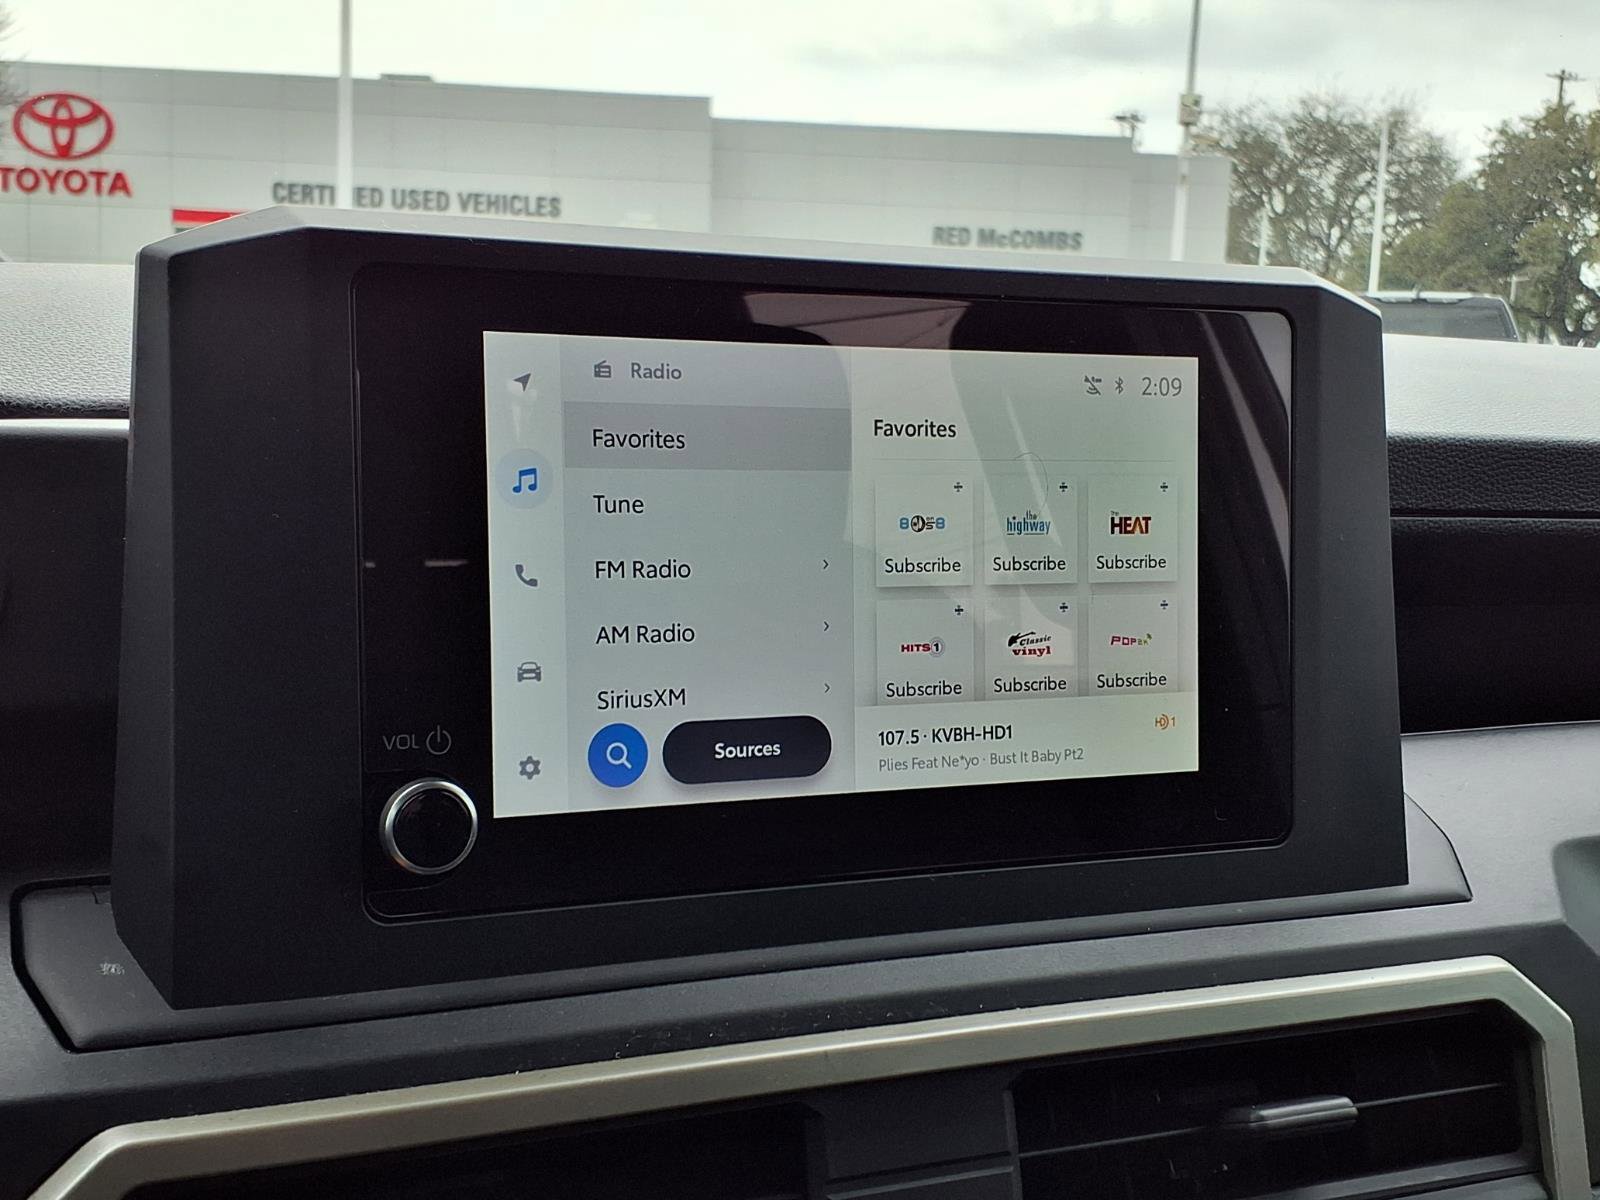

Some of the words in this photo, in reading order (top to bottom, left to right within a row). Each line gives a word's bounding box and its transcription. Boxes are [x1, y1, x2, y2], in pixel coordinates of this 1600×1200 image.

[0, 167, 132, 198] TOYOTA
[272, 182, 383, 208] CERTIED
[391, 188, 450, 211] USED
[457, 192, 561, 217] VEHICLES
[933, 226, 971, 246] RED
[977, 228, 1083, 250] McCOMBS
[631, 362, 682, 380] Radio
[1141, 377, 1183, 397] 2:09
[873, 419, 957, 438] Favorites
[592, 429, 686, 449] Favorites
[593, 495, 644, 514] Tune
[1006, 516, 1050, 536] highway
[1110, 516, 1151, 535] HEAT
[595, 560, 626, 579] FM
[633, 559, 691, 579] Radio
[884, 557, 962, 574] Subscribe
[992, 556, 1066, 572] Subscribe
[1096, 554, 1167, 570] Subscribe
[596, 626, 629, 645] AM
[636, 623, 695, 644] Radio
[1019, 633, 1051, 647] Classic
[1012, 645, 1051, 657] vinyl
[886, 682, 963, 698] Subscribe
[993, 677, 1067, 694] Subscribe
[1097, 673, 1168, 689] Subscribe
[597, 688, 686, 710] SiriusXM
[382, 734, 421, 750] VOL
[878, 729, 919, 746] 107.5
[932, 725, 1012, 743] KVBH-HD1
[714, 742, 781, 760] Sources
[879, 758, 908, 772] Plies
[912, 756, 938, 770] Feat
[990, 752, 1017, 765] Bust
[1020, 751, 1029, 763] It
[1032, 749, 1061, 764] Baby
[1064, 748, 1084, 761] Pt2
